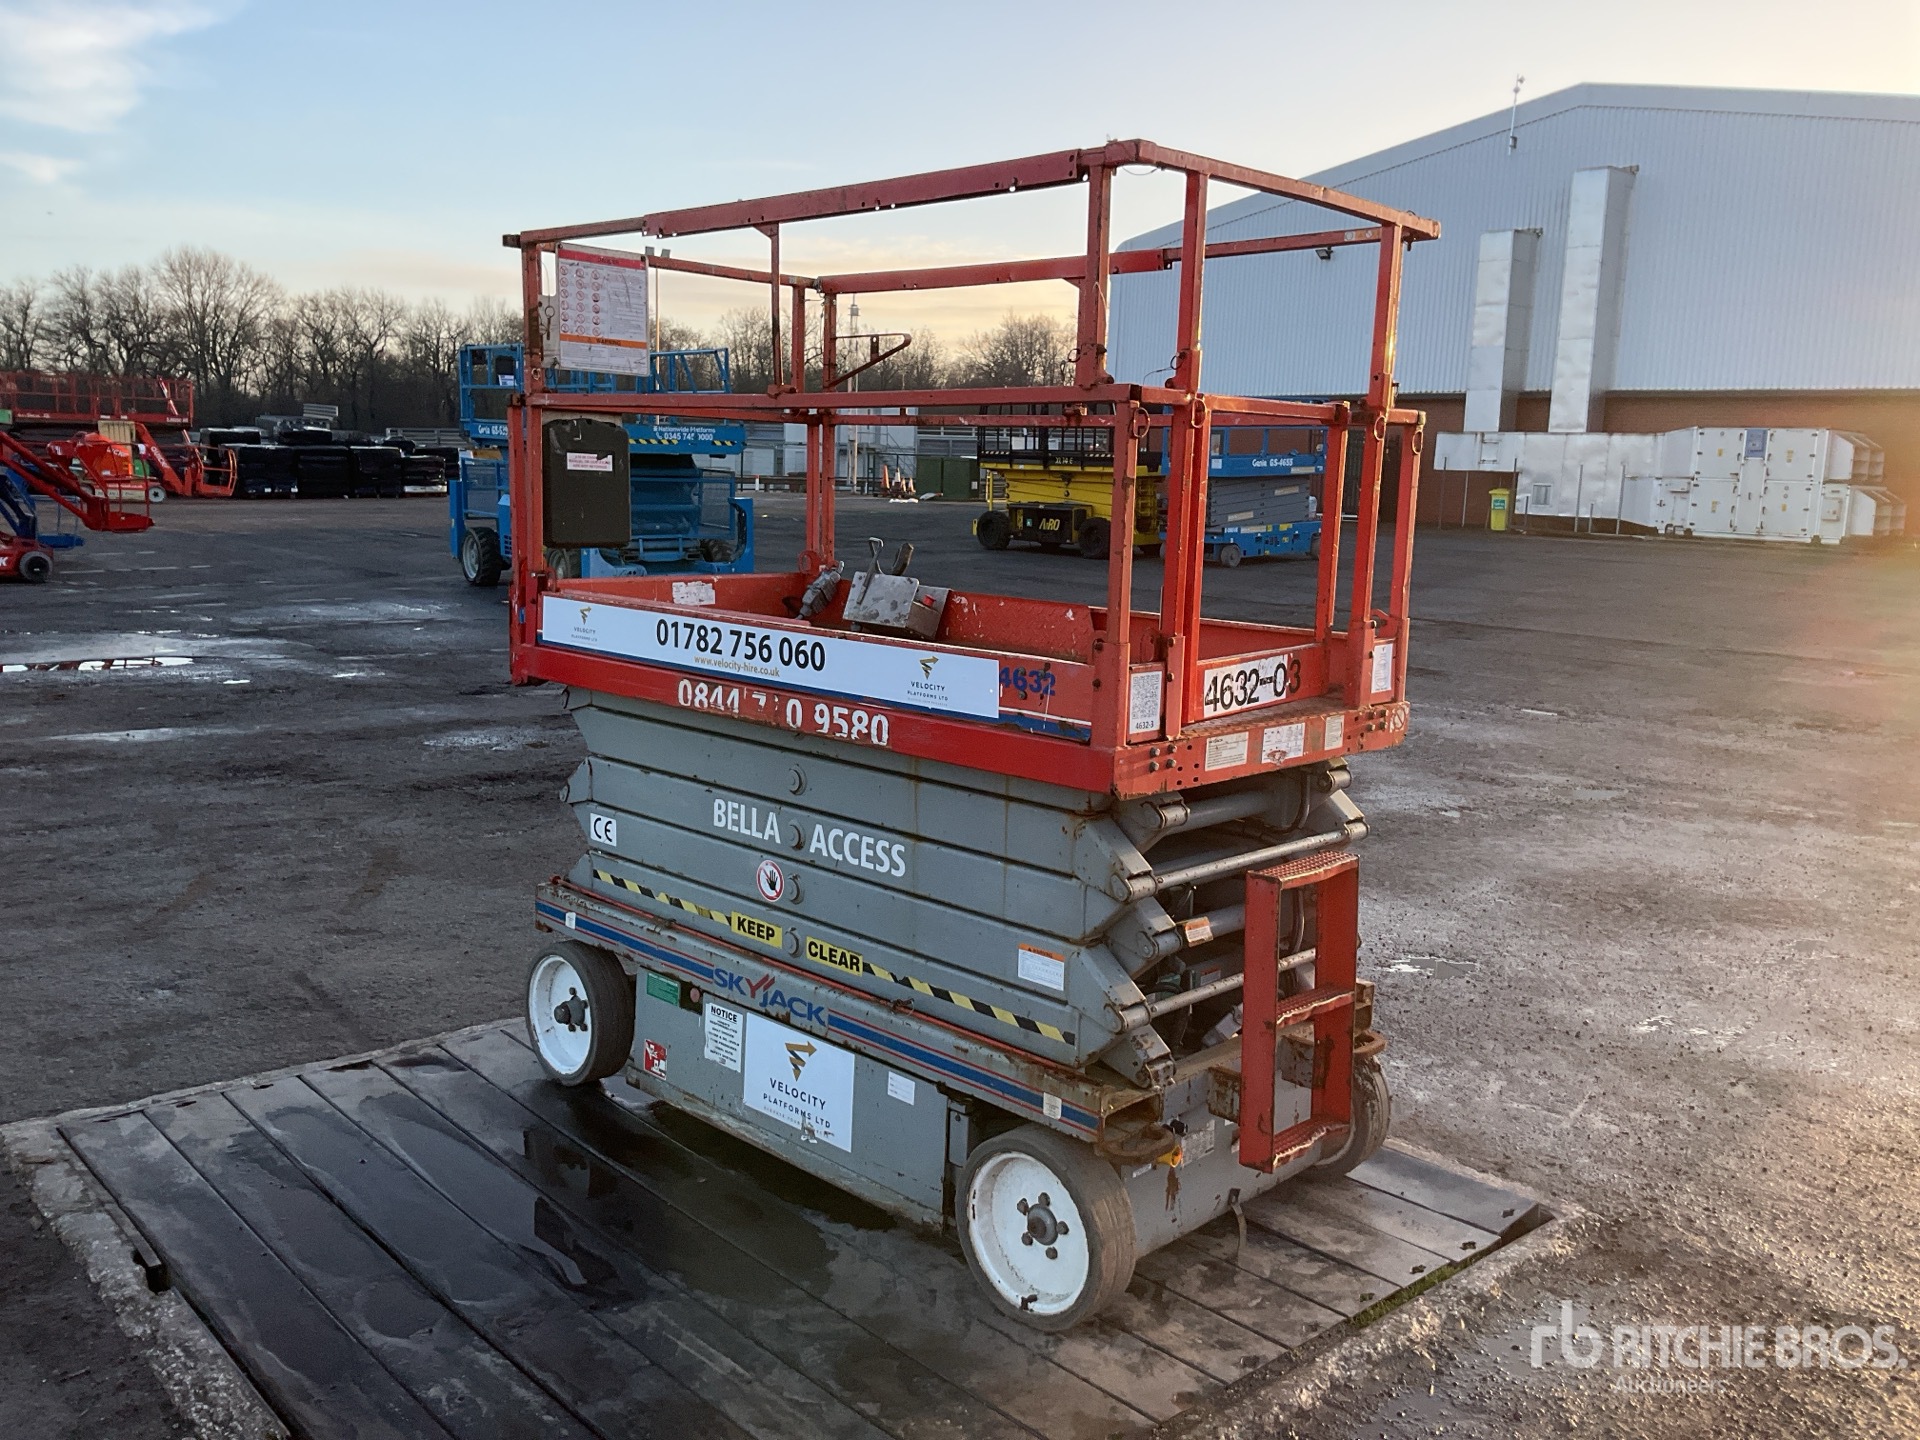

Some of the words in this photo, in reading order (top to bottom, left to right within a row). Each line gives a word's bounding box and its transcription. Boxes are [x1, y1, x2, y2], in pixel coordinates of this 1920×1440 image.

[664, 432, 681, 440] 0345
[1252, 458, 1267, 467] Genie
[573, 626, 596, 634] VELOCITY
[656, 618, 722, 655] 01782
[730, 629, 772, 663] 756
[779, 637, 826, 671] 060
[694, 656, 780, 677] www.velocity-hire.co.uk
[910, 680, 945, 692] VELOCITY
[1000, 666, 1056, 696] 4632
[1204, 658, 1301, 712] 4632-03
[907, 690, 937, 700] PLATFORMS
[938, 692, 949, 701] LTD
[814, 703, 889, 746] 9580
[1135, 720, 1154, 730] 4632-3
[594, 817, 612, 842] CE
[713, 798, 781, 844] BELLA
[809, 823, 906, 877] ACCESS
[737, 916, 775, 941] KEEP
[808, 941, 860, 972] CLEAR
[714, 968, 827, 1027] SKYJACK
[711, 1005, 738, 1022] NOTICE
[769, 1077, 826, 1110] VELOCITY
[763, 1092, 812, 1120] PLATFORMS
[815, 1116, 831, 1129] LTD
